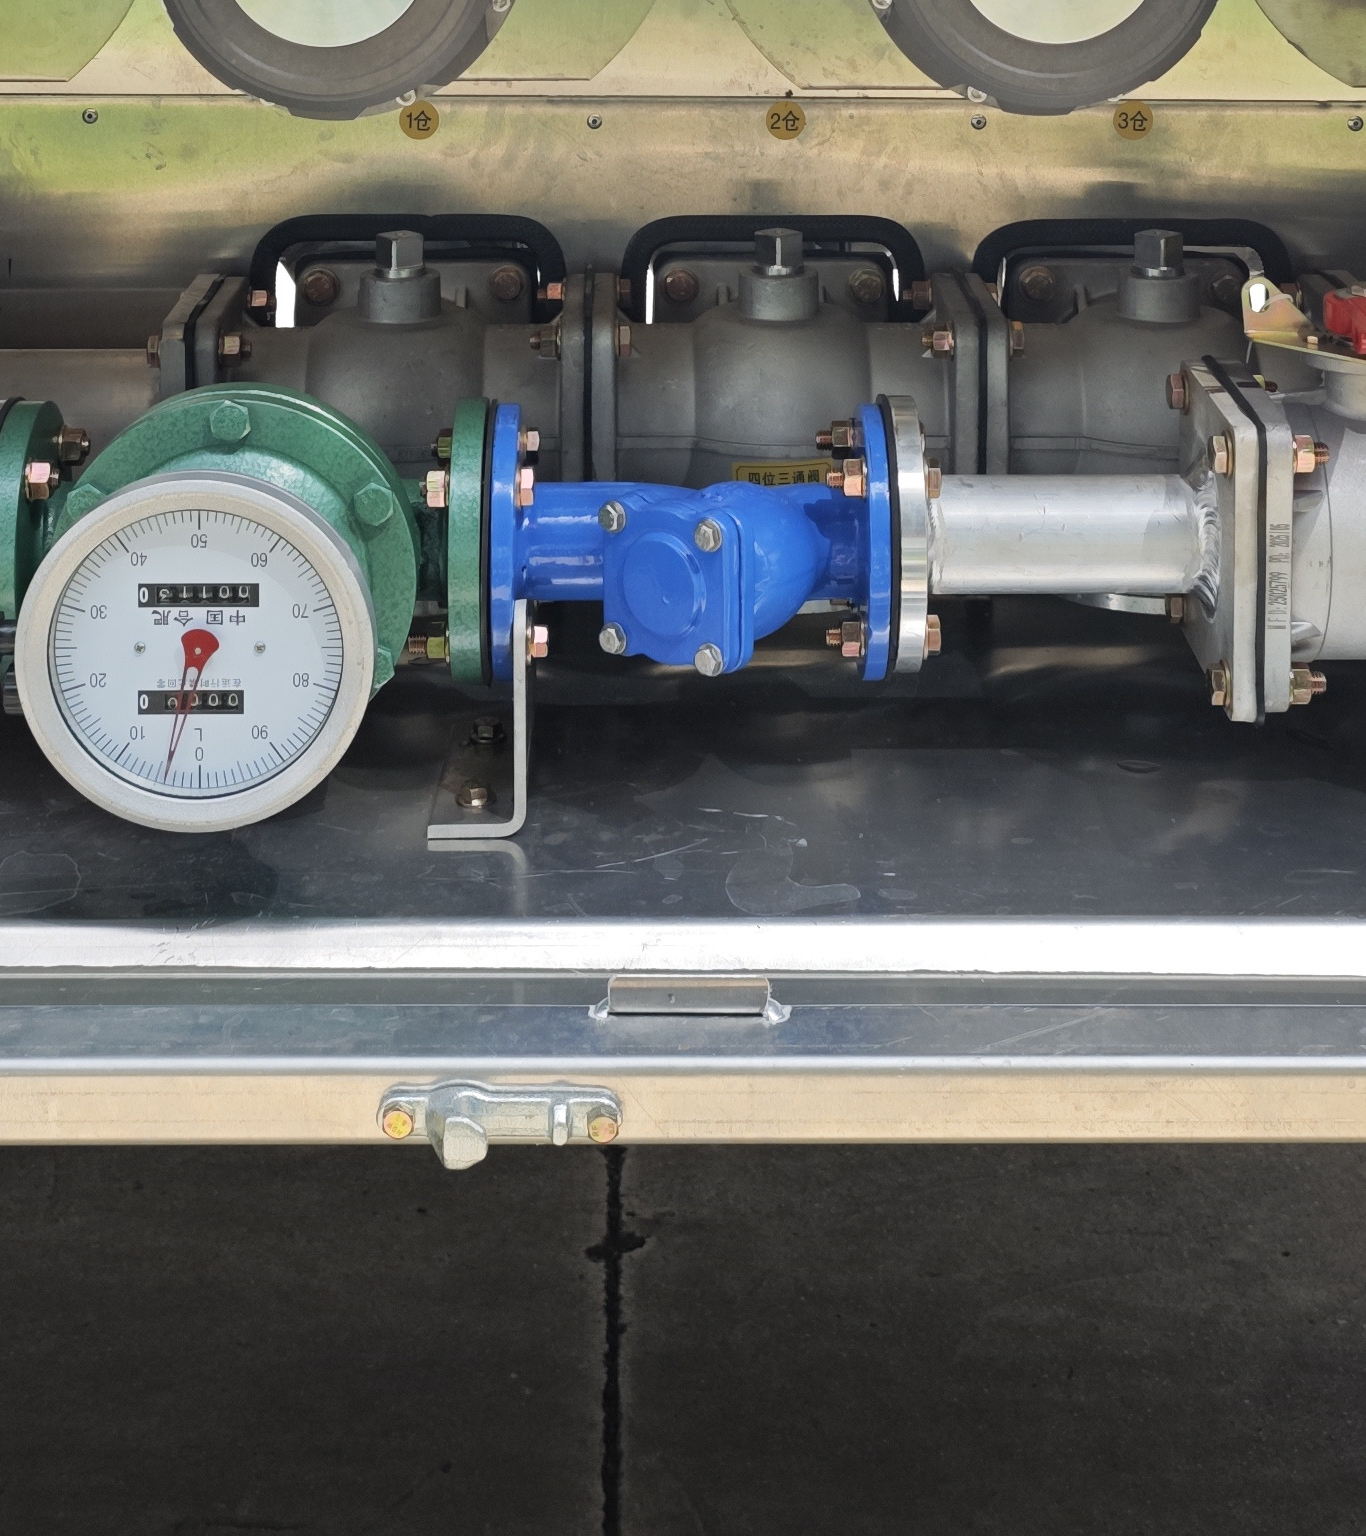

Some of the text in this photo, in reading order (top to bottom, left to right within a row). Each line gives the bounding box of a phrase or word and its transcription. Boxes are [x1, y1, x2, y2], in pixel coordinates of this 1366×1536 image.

[406, 111, 432, 131] 1仓
[770, 111, 800, 131] 2仓
[1118, 111, 1148, 131] 3仓
[748, 469, 820, 486] 四位三通阀
[190, 533, 208, 549] 50
[130, 552, 148, 567] 40
[251, 552, 268, 568] 60
[91, 605, 107, 619] 30
[151, 609, 246, 627] 中国 合肥
[292, 604, 309, 619] 70
[90, 673, 107, 687] 20
[292, 673, 309, 687] 80
[130, 725, 146, 740] 10
[194, 727, 203, 742] L
[251, 725, 268, 739] 90
[195, 747, 204, 762] 0
